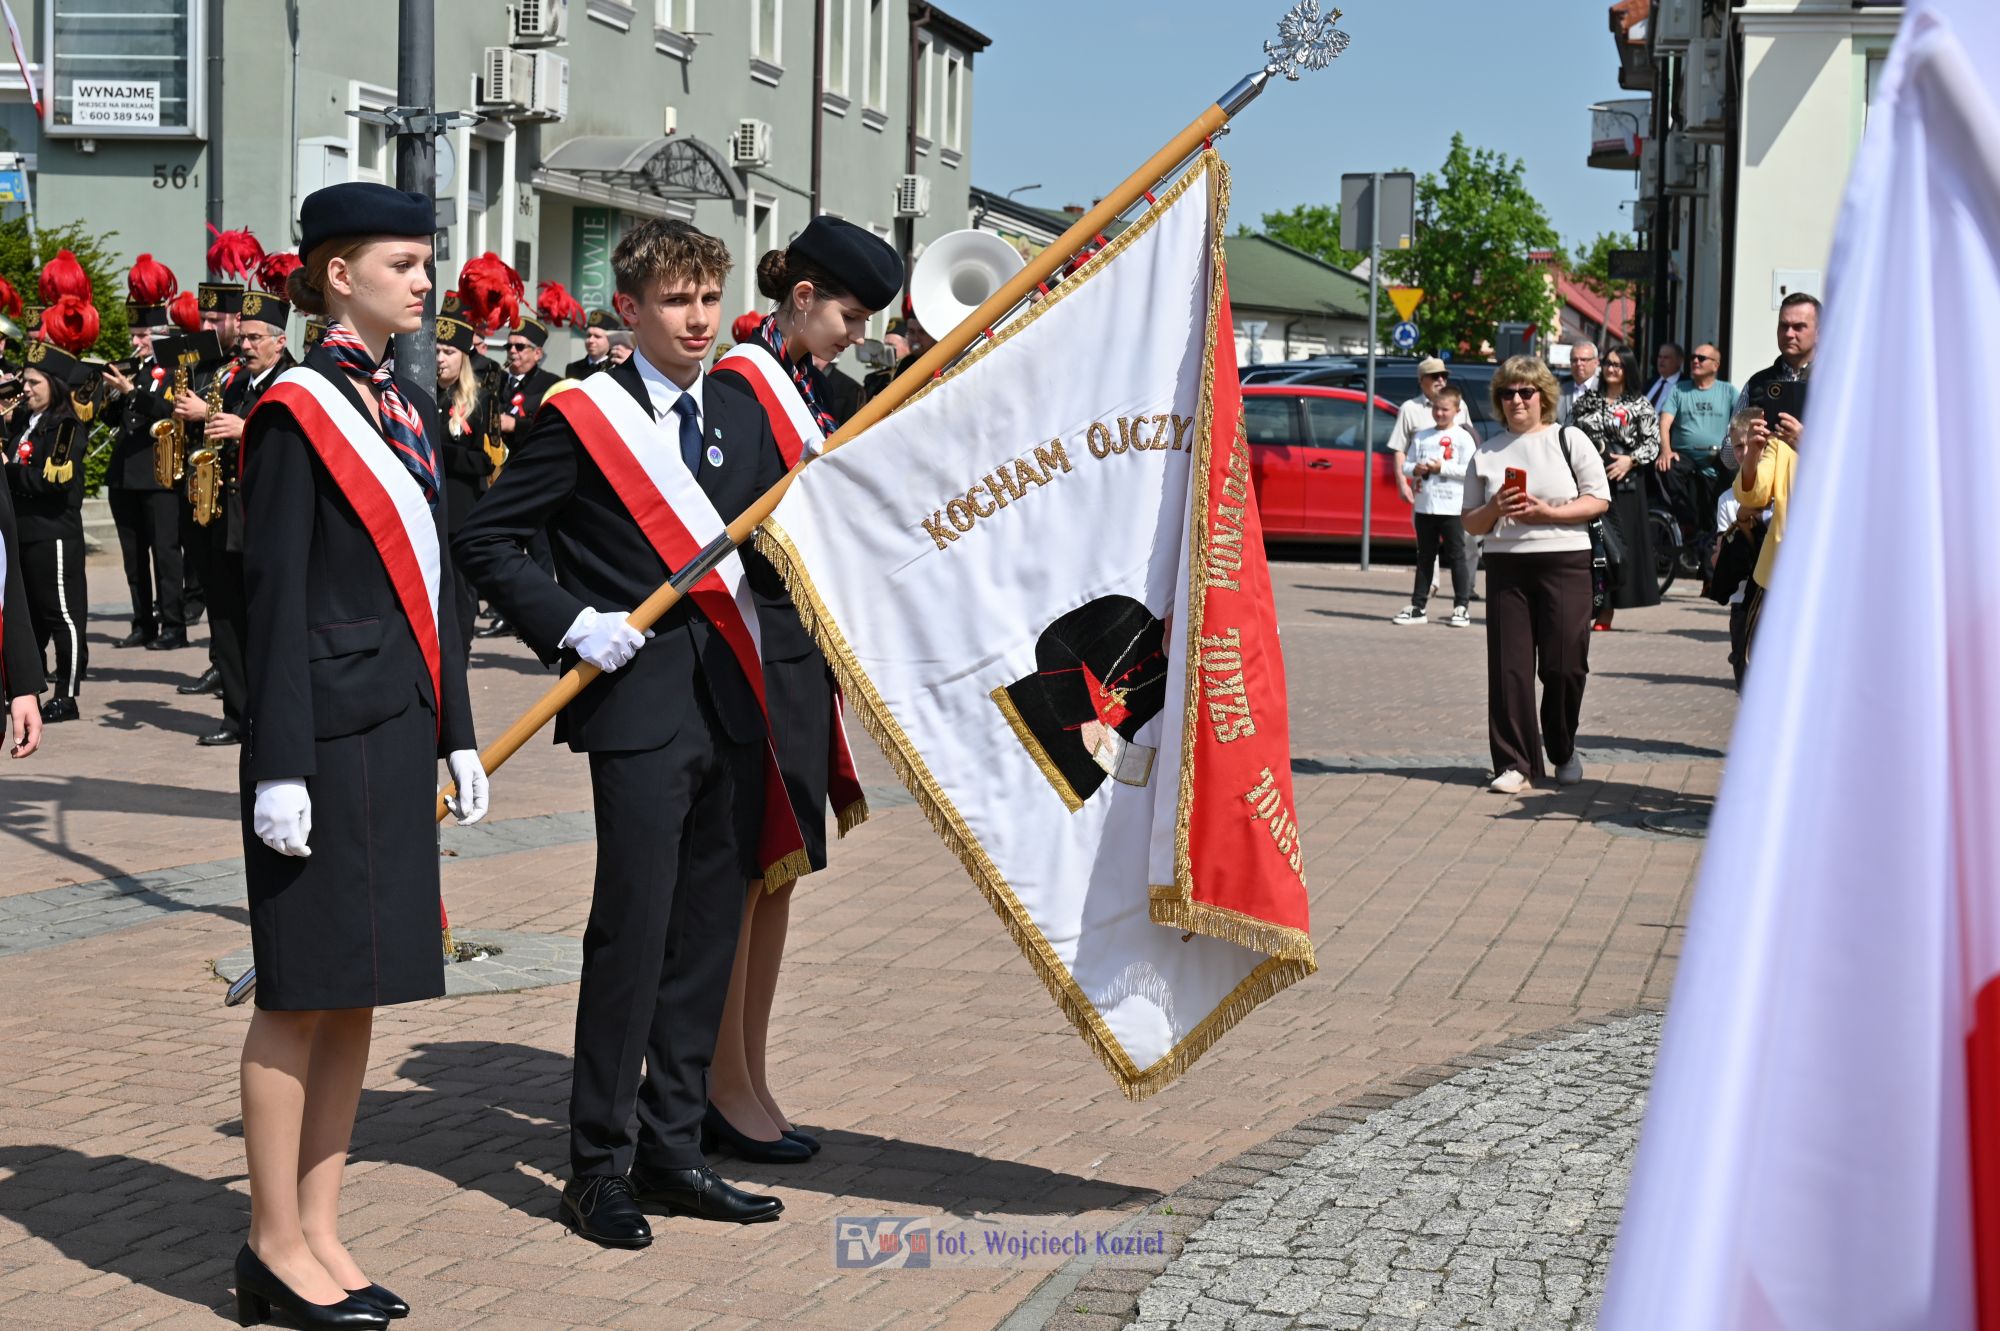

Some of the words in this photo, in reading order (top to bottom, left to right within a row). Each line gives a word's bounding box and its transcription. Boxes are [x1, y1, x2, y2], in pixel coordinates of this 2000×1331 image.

[79, 86, 154, 101] WYNAJMĘ
[89, 111, 110, 120] 600
[113, 112, 132, 120] 389
[135, 112, 154, 121] 549
[152, 164, 188, 189] 56
[921, 438, 1073, 550] KOCHAM
[1086, 414, 1193, 459] OJCZY
